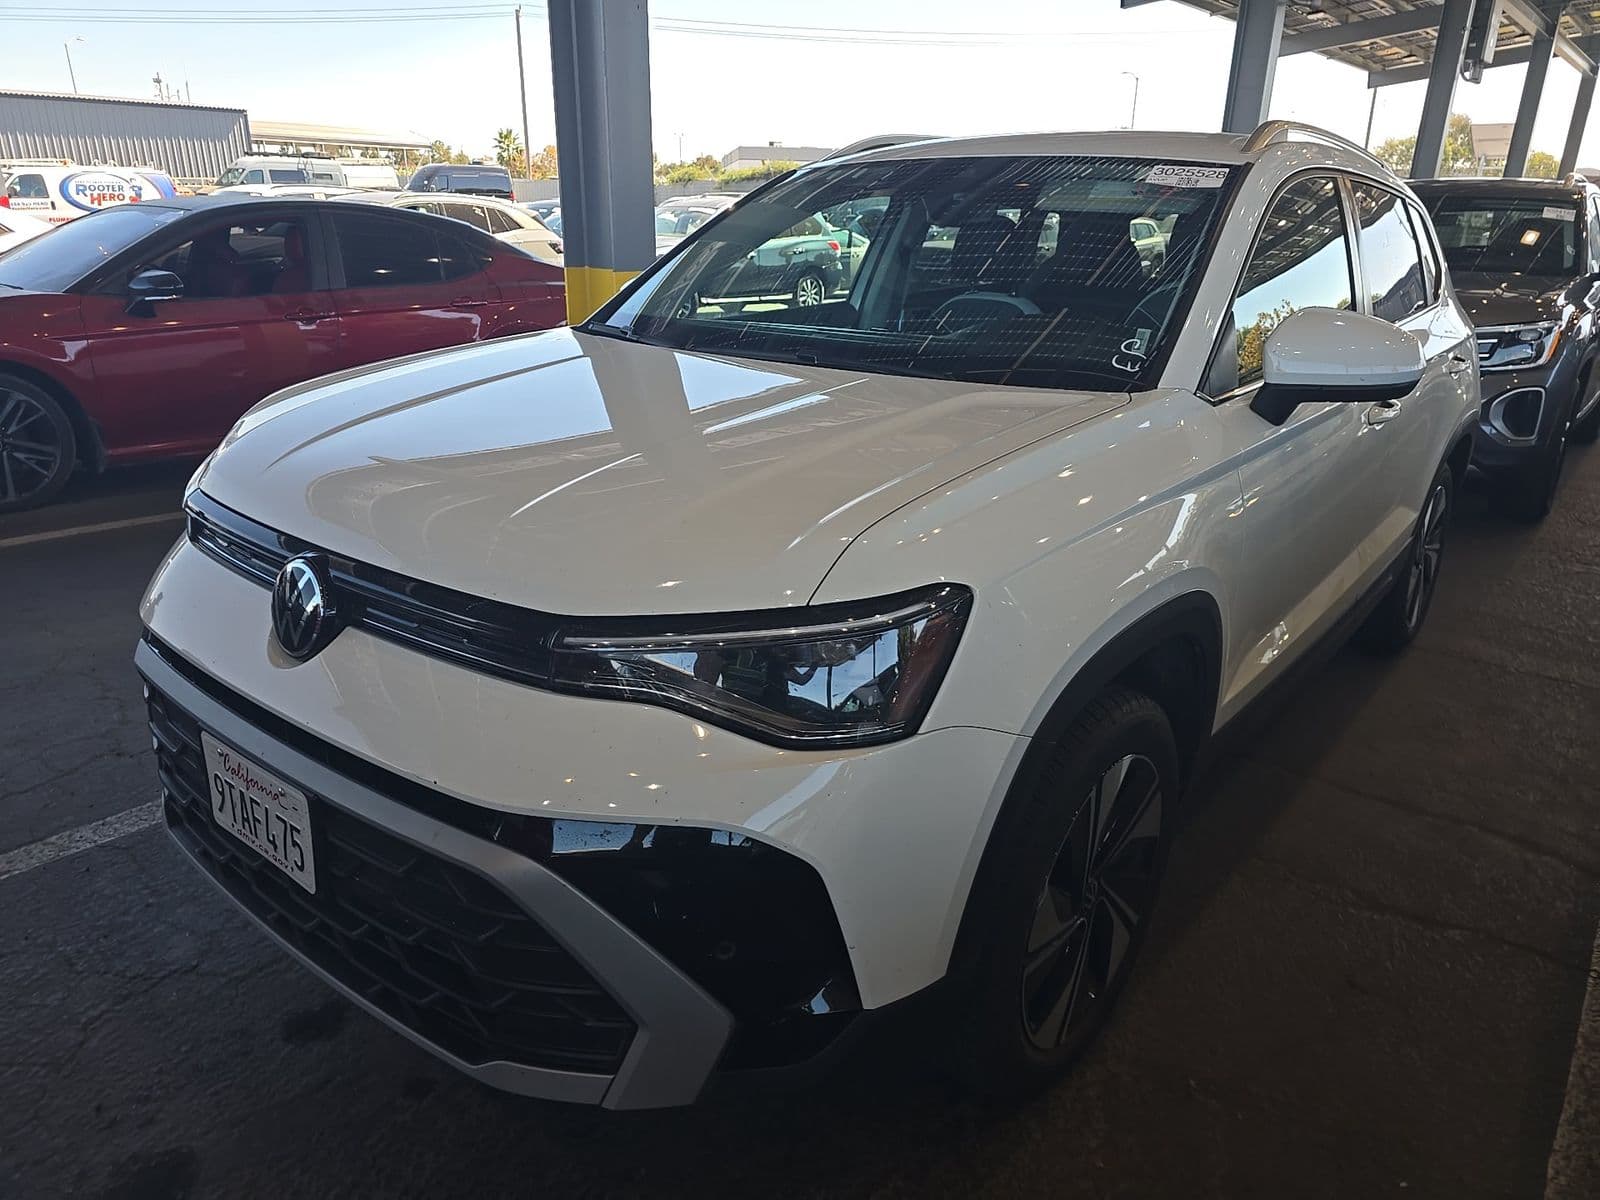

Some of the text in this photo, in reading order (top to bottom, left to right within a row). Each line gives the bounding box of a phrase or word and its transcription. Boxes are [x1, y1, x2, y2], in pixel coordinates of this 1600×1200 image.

[1153, 167, 1226, 179] 3025528
[75, 184, 124, 197] ROOTER
[90, 193, 125, 206] HERO
[223, 753, 288, 811] California
[213, 772, 305, 873] 9TAF475
[236, 827, 289, 869] dmv.ca.gov
